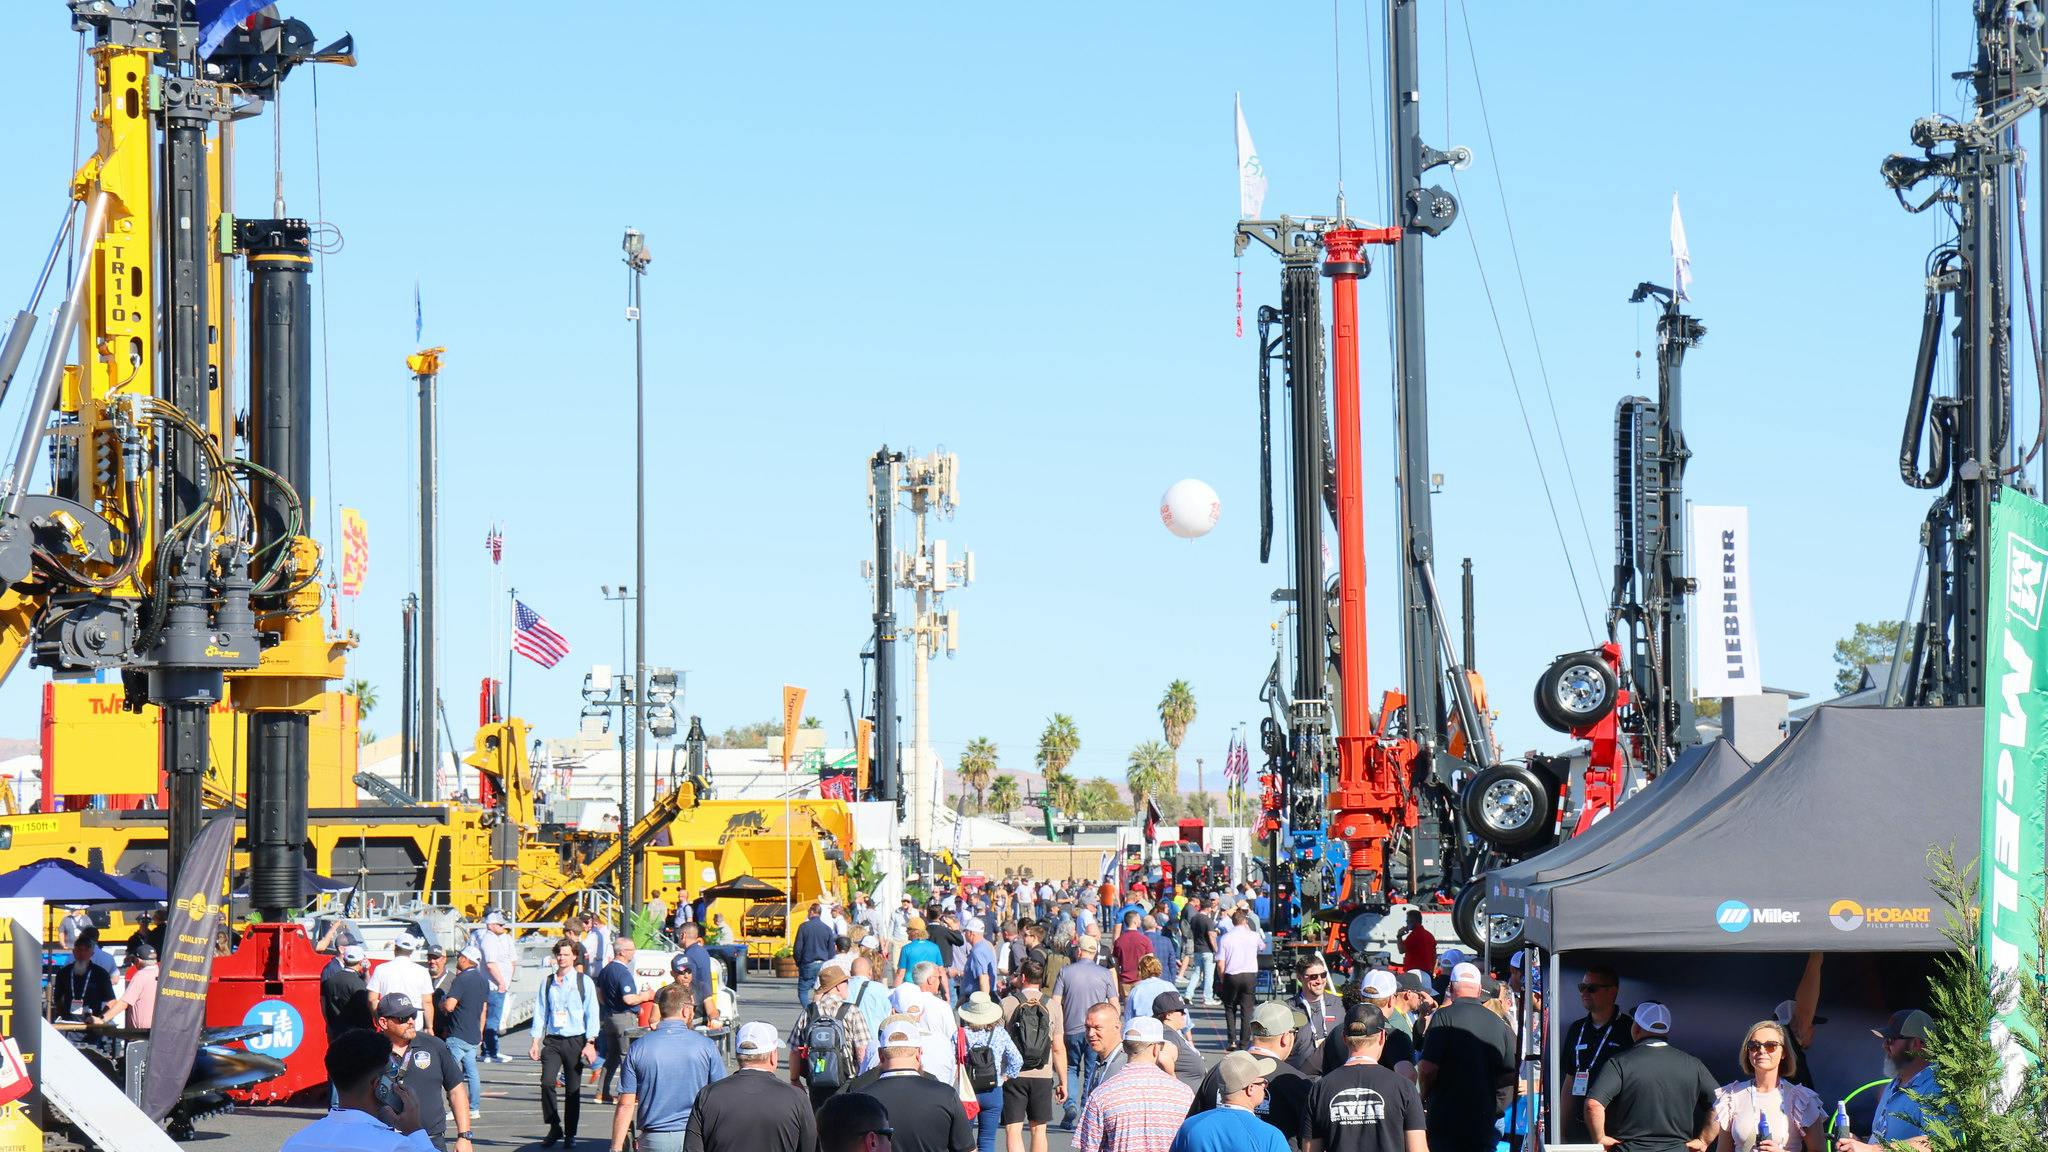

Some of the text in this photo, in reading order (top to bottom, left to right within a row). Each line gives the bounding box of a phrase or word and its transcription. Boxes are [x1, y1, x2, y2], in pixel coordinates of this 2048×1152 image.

[112, 246, 125, 321] TR110
[1722, 529, 1745, 679] LIEBHERR
[27, 822, 48, 831] 150ft
[1866, 907, 1930, 922] HOBART
[179, 934, 208, 945] QUALITY
[174, 952, 205, 963] INTEGRITY
[161, 987, 185, 998] SUPER
